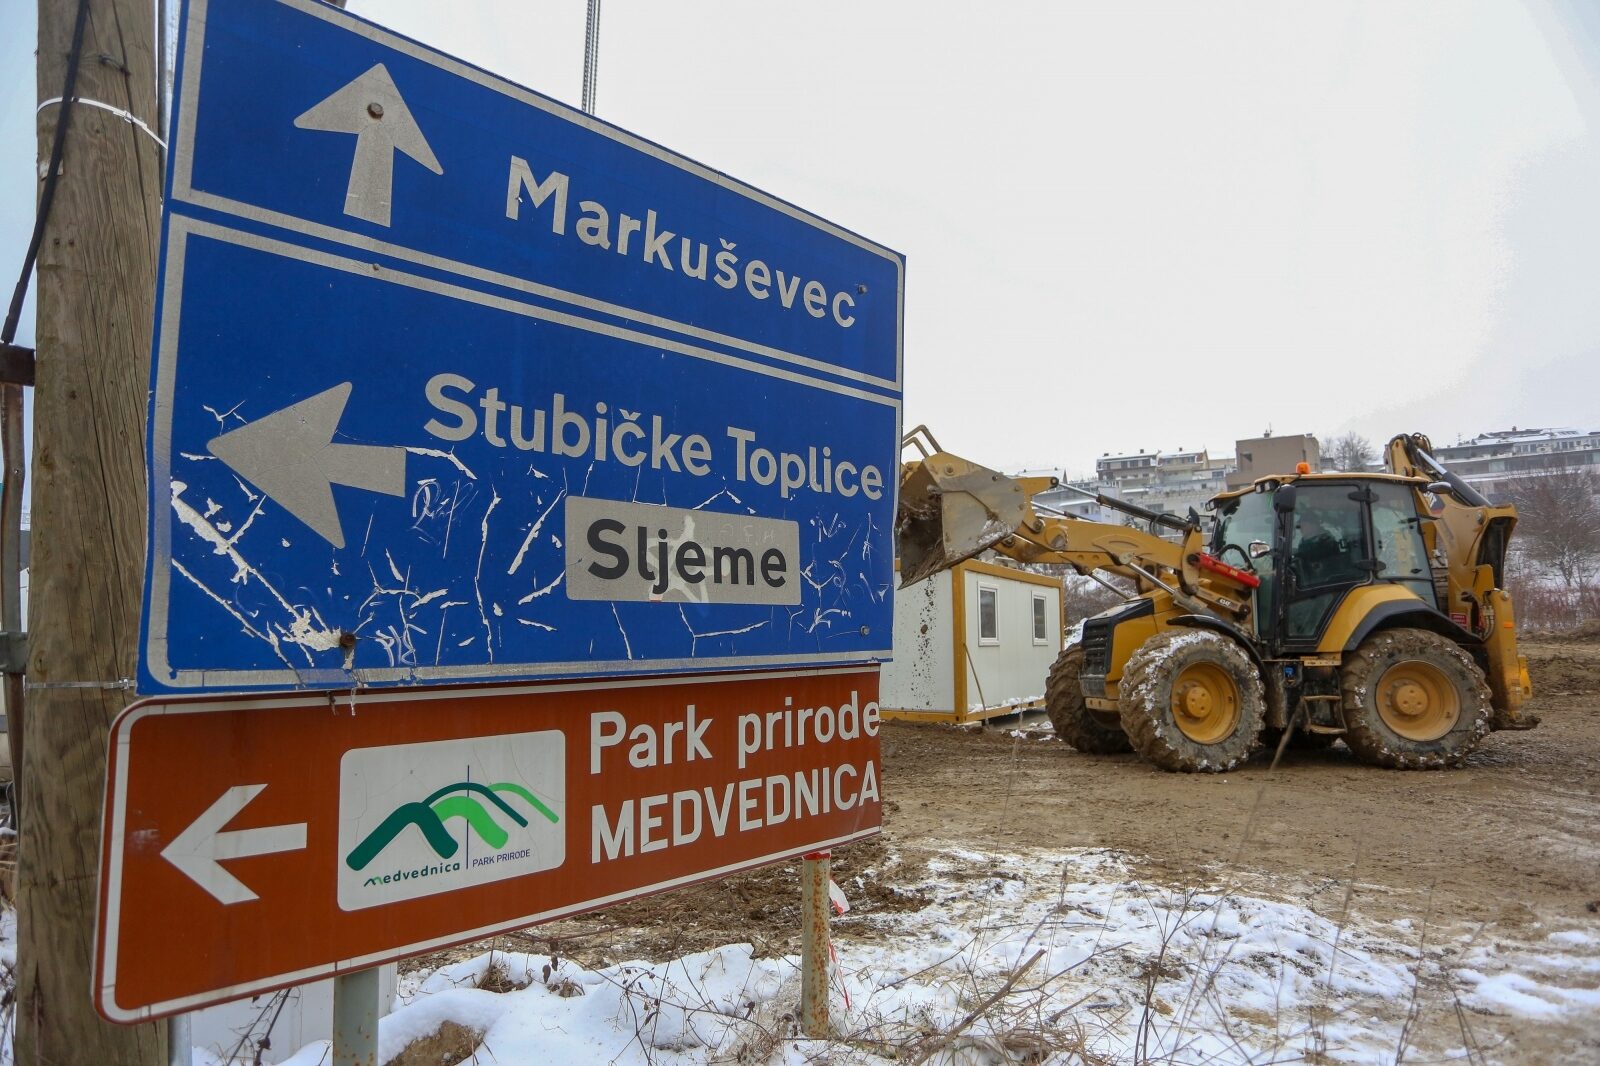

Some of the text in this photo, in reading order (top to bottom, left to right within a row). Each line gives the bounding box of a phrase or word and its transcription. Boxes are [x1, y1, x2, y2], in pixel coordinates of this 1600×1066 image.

[506, 155, 856, 328] Markuševec
[424, 373, 884, 500] Stubičke Toplice
[586, 518, 787, 595] Sljeme
[590, 690, 880, 775] Park prirode
[472, 848, 531, 868] PARK PRIRODE
[590, 760, 880, 864] MEDVEDNICA
